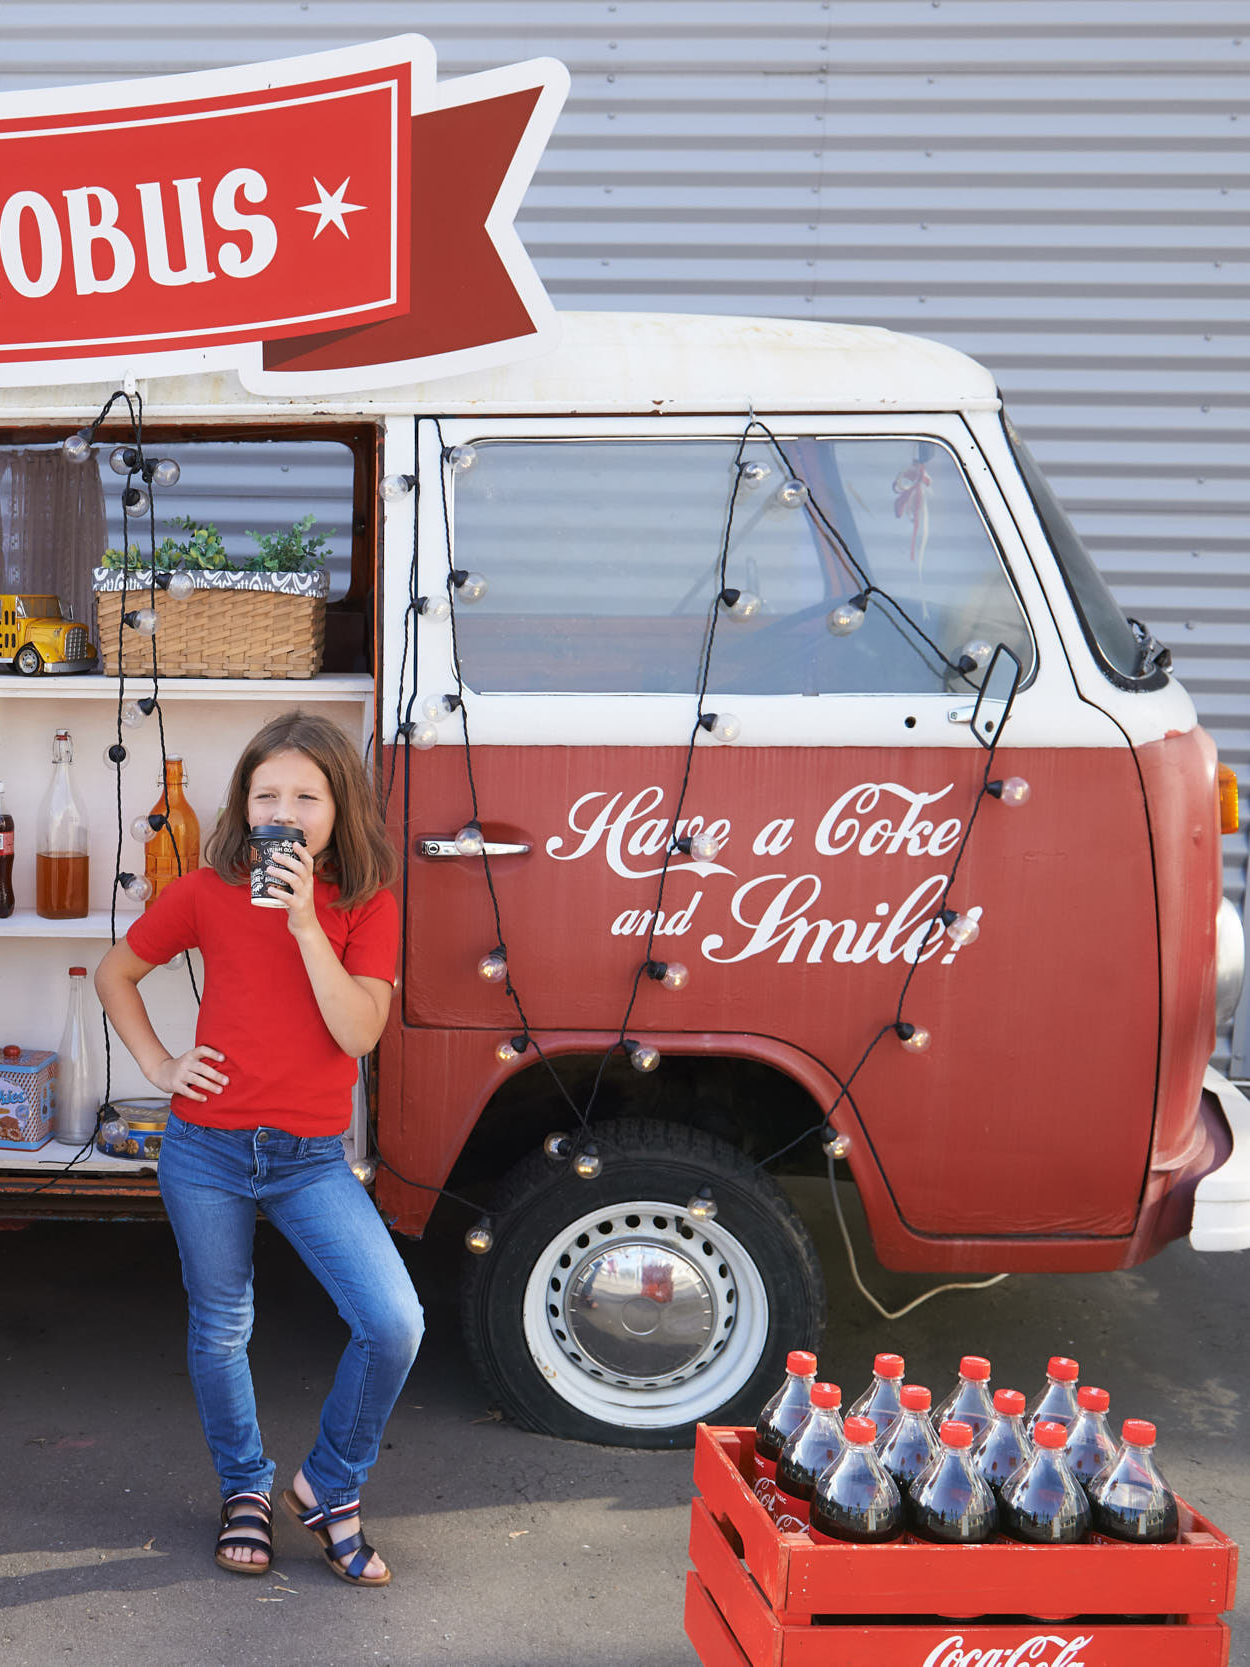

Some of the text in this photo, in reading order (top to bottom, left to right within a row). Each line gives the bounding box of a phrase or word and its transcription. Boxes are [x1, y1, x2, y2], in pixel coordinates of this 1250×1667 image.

[545, 782, 963, 879] Have a Coke
[610, 873, 984, 965] and Smile!
[922, 1634, 1094, 1667] Coca-Cl
